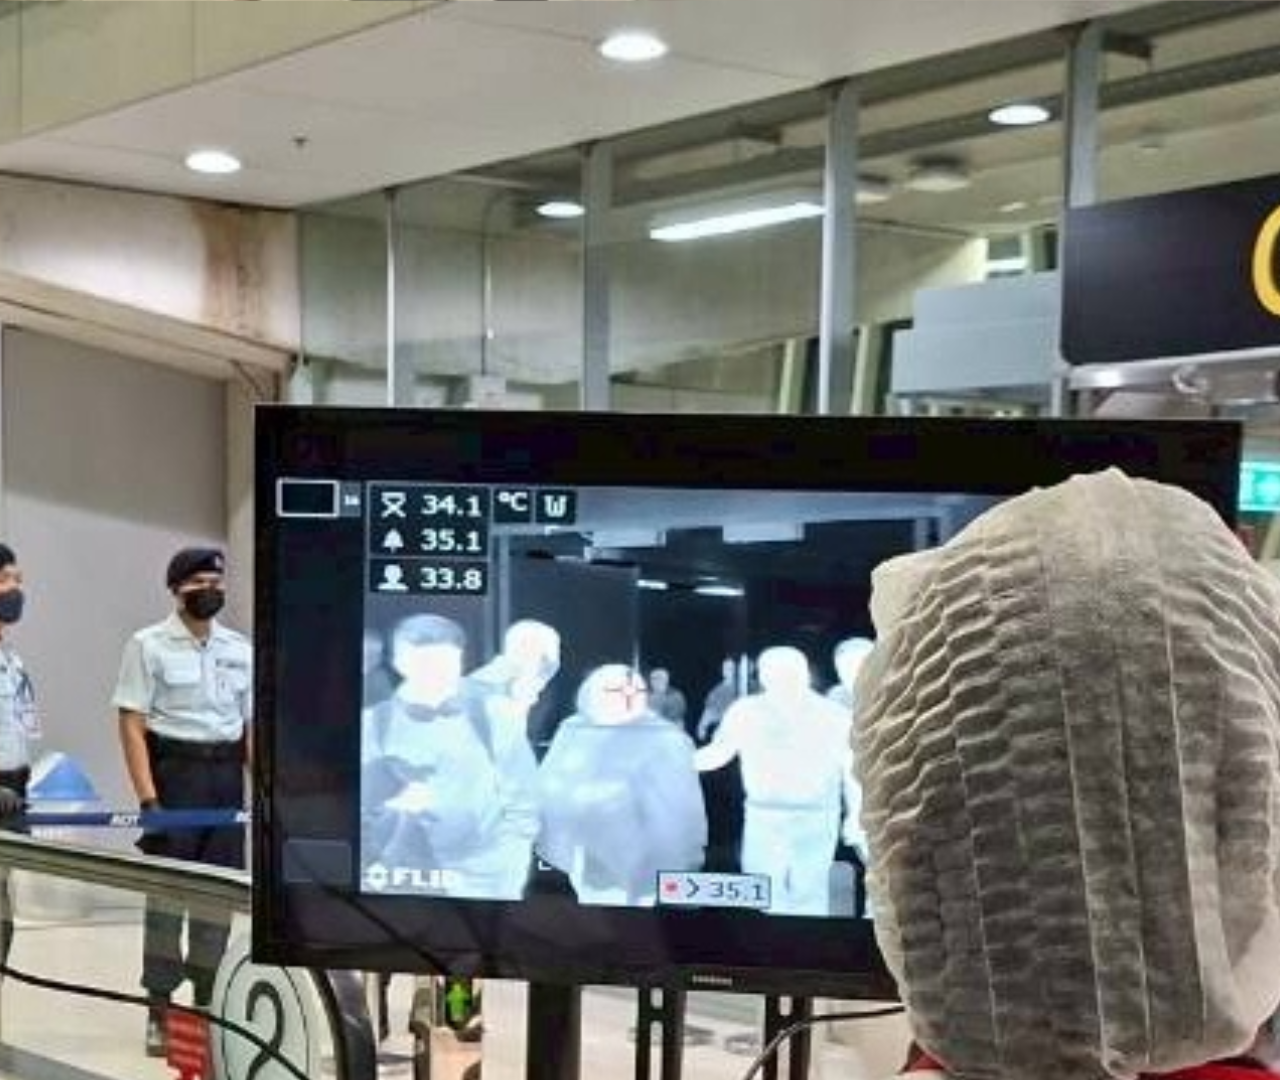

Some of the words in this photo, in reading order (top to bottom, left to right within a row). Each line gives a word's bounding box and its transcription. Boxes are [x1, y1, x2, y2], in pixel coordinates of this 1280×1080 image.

[420, 494, 482, 518] 34.1
[420, 528, 482, 551] 35.1
[420, 567, 482, 590] 33.8
[709, 882, 766, 901] 35.1
